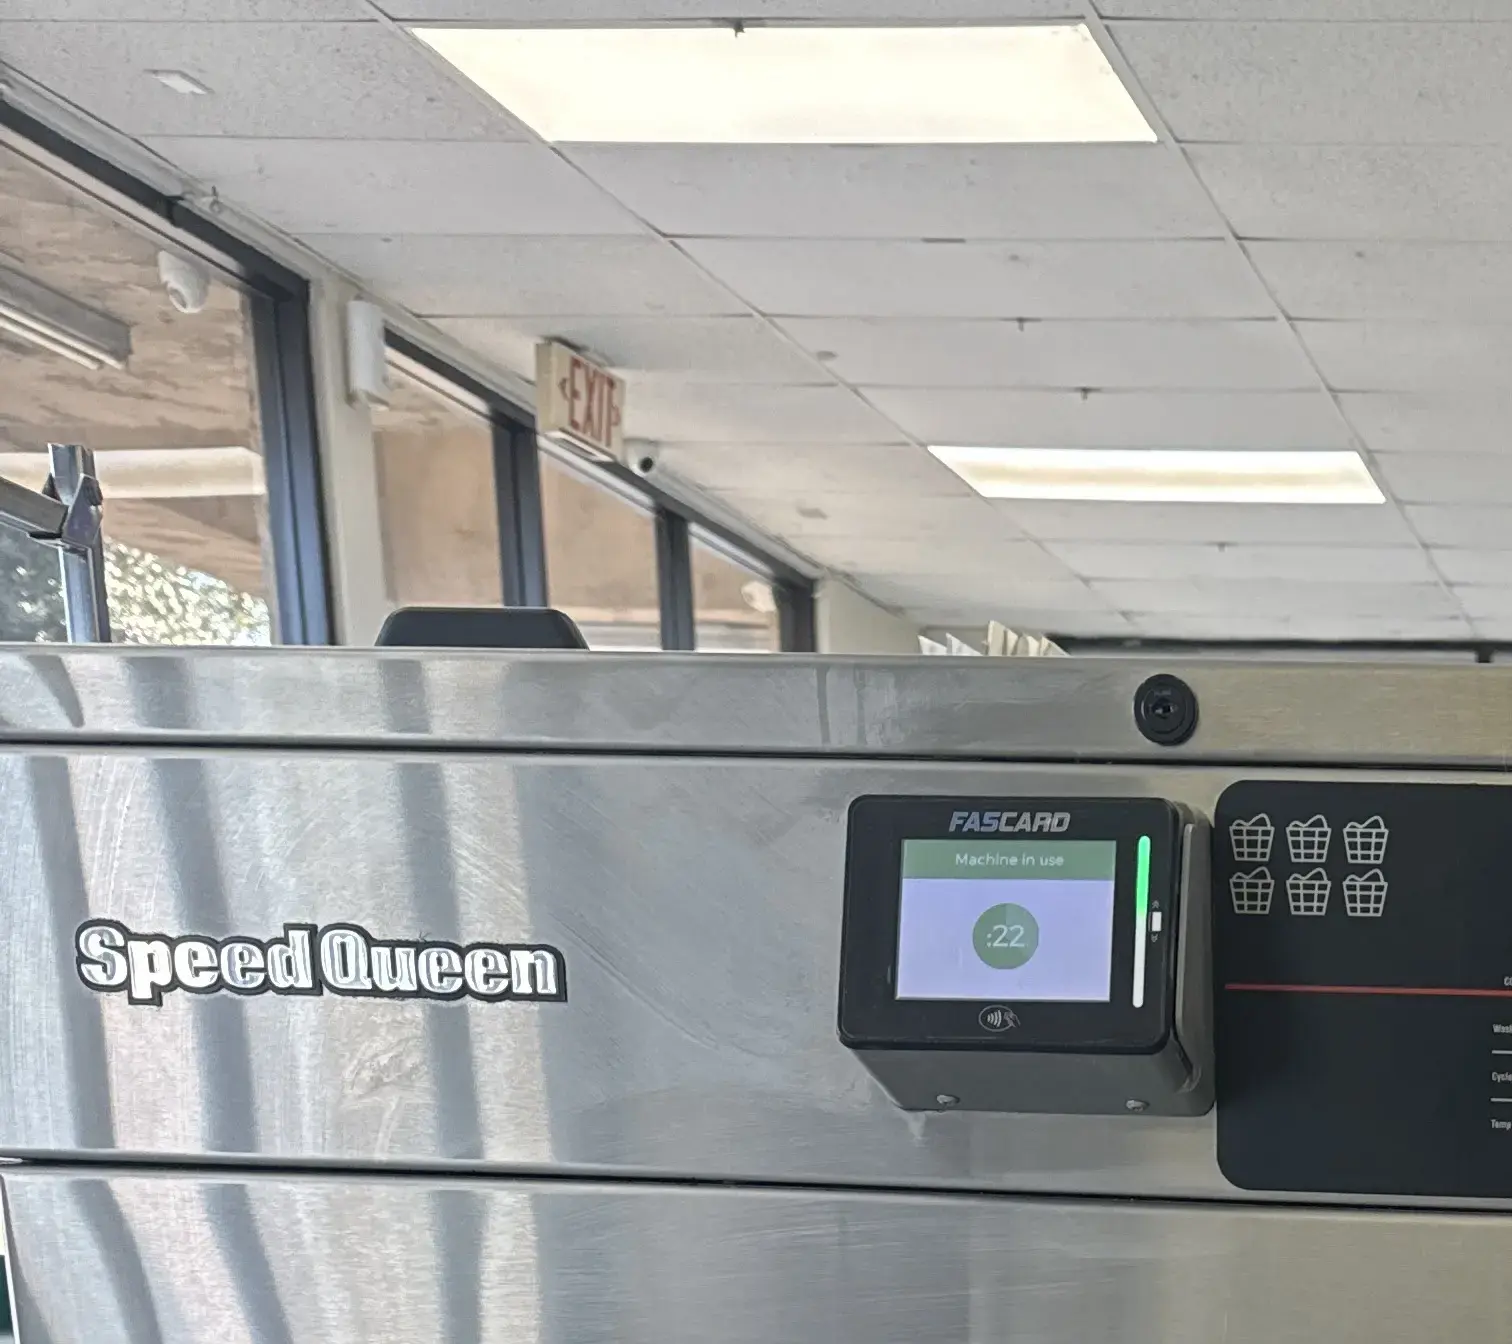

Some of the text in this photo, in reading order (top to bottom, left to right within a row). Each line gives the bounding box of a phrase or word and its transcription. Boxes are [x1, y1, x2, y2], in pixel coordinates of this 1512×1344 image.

[568, 356, 614, 447] EXIT
[949, 811, 1071, 833] FASCARD
[955, 852, 1064, 867] Machine in use
[76, 920, 567, 1005] Speed Queen
[1491, 1072, 1512, 1083] Cycle
[1490, 1120, 1512, 1131] Temp
